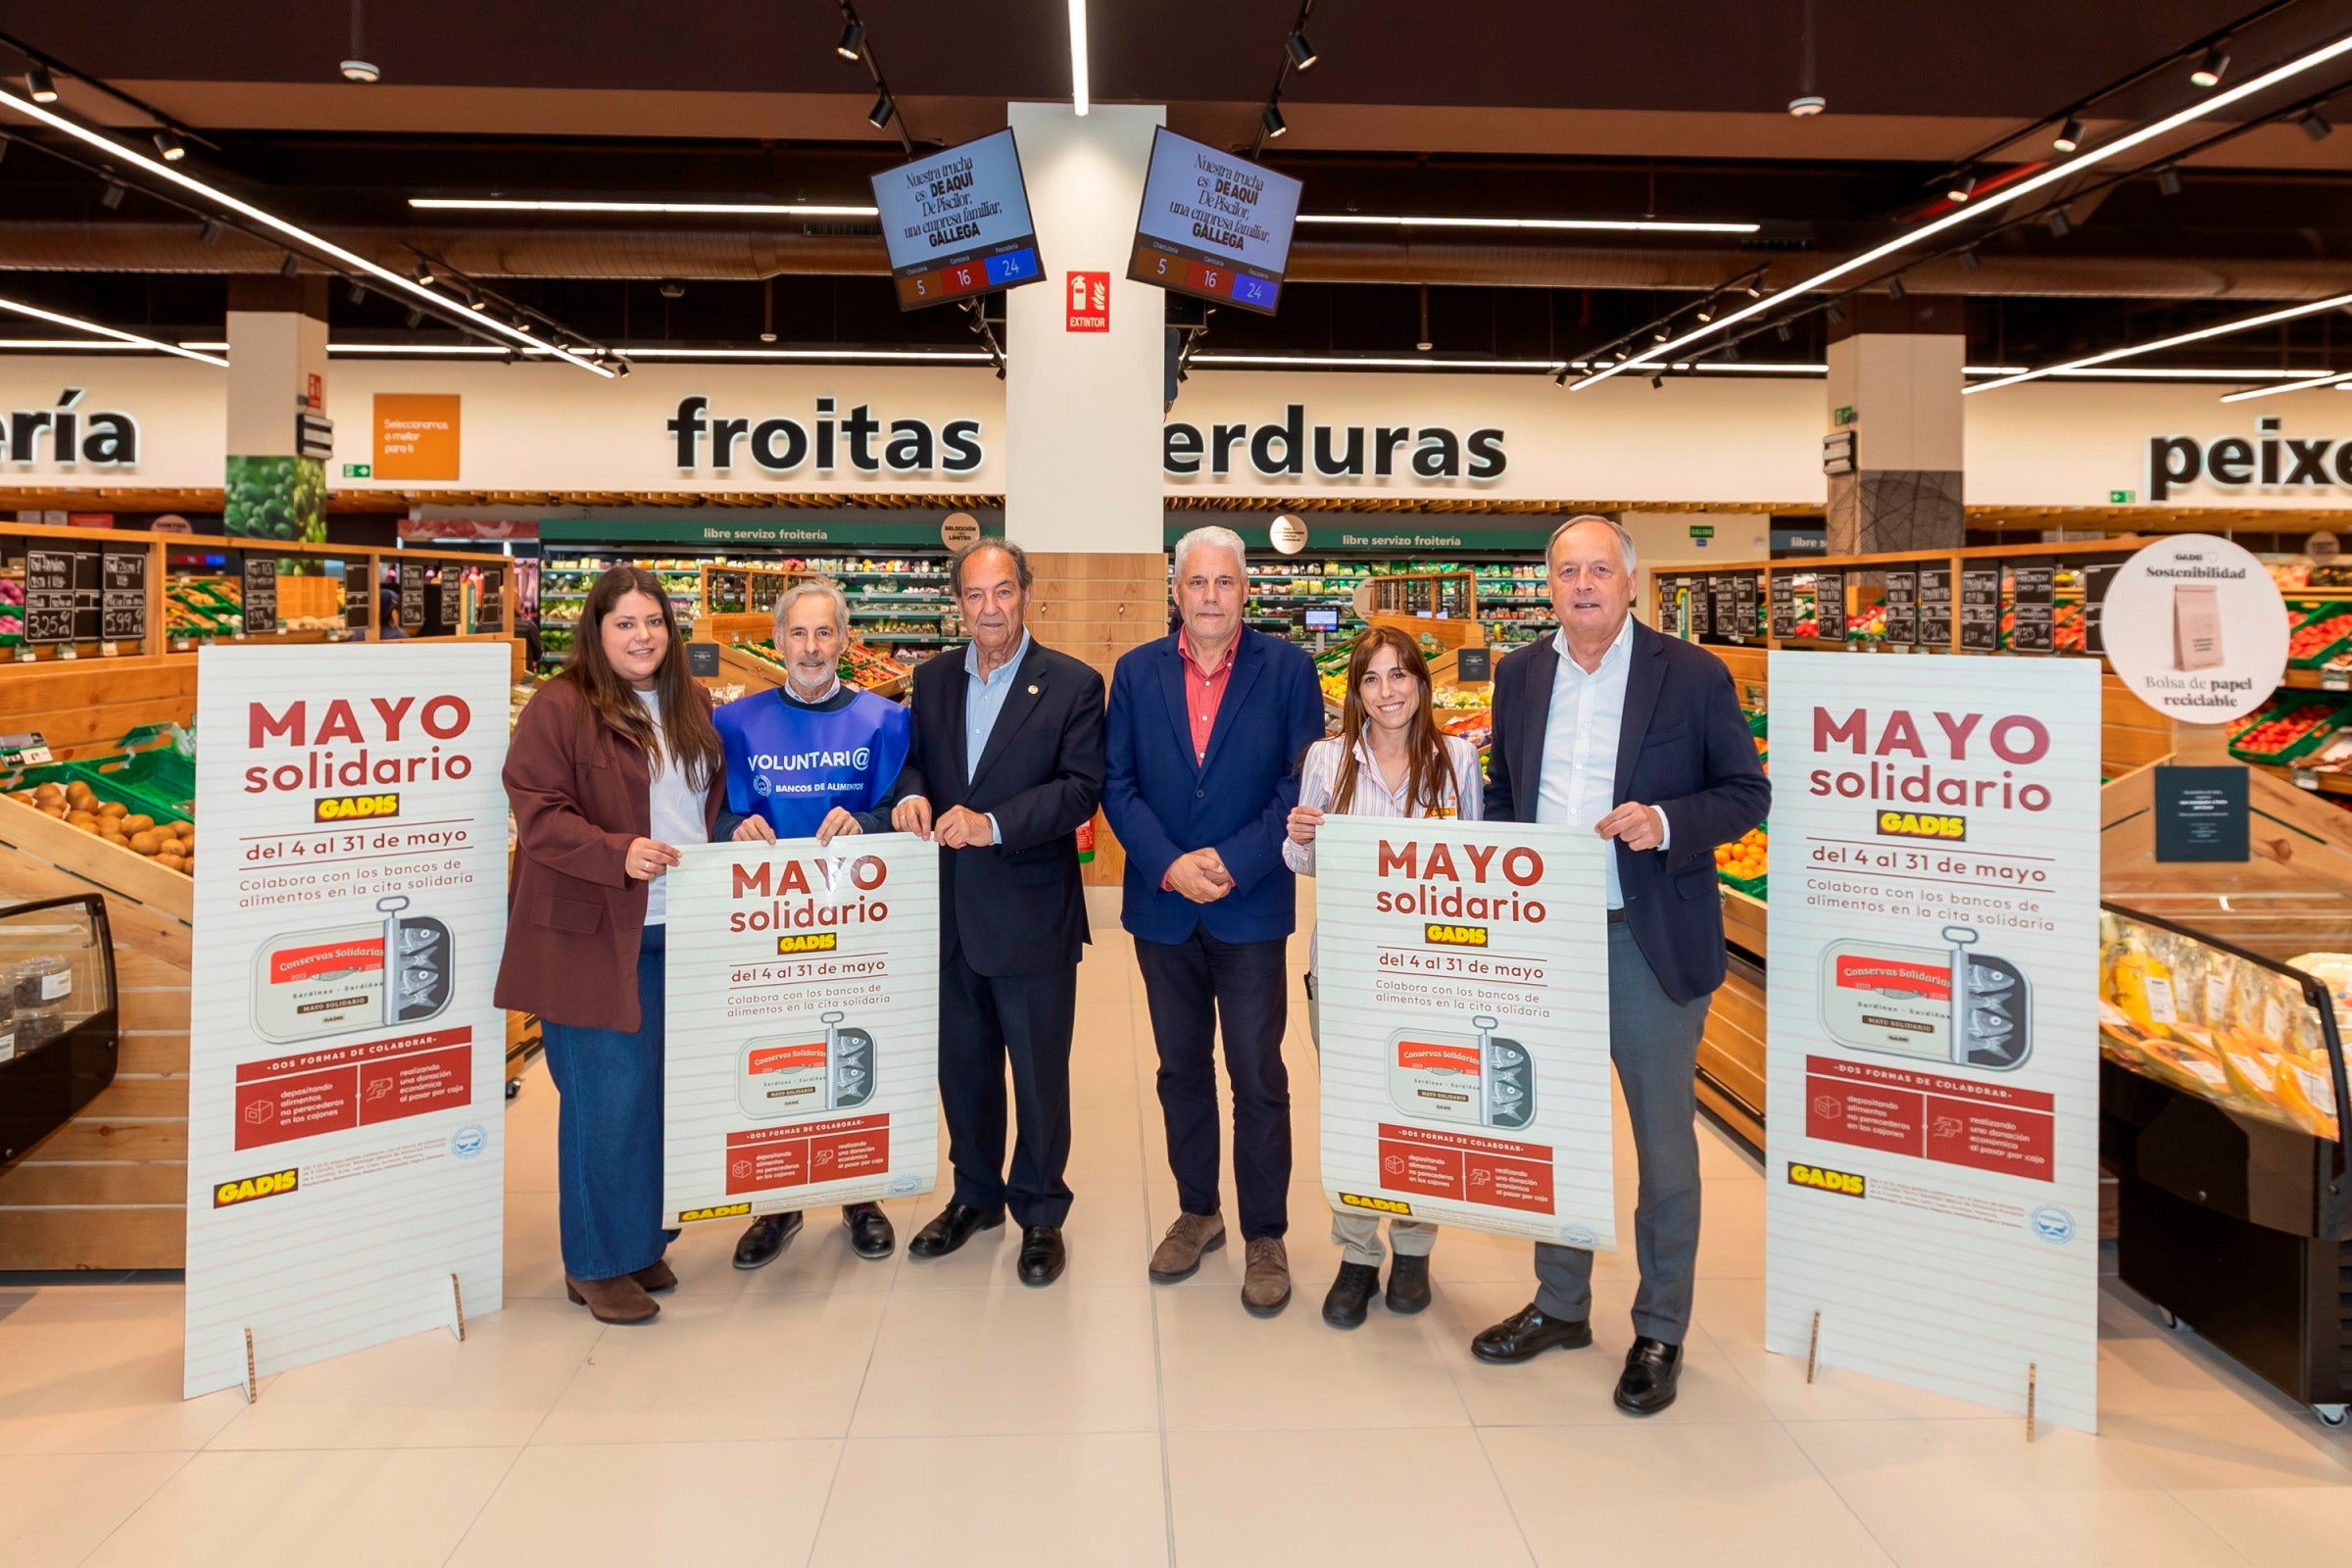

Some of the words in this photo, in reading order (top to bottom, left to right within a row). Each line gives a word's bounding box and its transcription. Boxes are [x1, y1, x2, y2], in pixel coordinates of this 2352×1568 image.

[907, 166, 941, 188] Nuestra
[942, 157, 973, 177] trucha
[1194, 154, 1232, 178] Nuestra
[1234, 170, 1264, 191] trucha
[915, 190, 924, 202] es
[931, 180, 945, 197] DE
[1198, 176, 1208, 187] es
[1215, 179, 1231, 195] DE
[923, 203, 935, 217] De
[1198, 190, 1214, 208] De
[905, 224, 921, 238] una
[923, 211, 961, 234] empresa
[963, 200, 1002, 222] familiar,
[1170, 201, 1189, 216] una
[1191, 206, 1232, 230] empresa
[1235, 219, 1270, 243] familiar,
[929, 222, 980, 247] GALLEGA
[1192, 222, 1244, 250] GALLEGA
[957, 269, 971, 285] 16
[1003, 258, 1019, 276] 24
[1157, 258, 1167, 274] 5
[917, 280, 925, 294] 5
[1205, 270, 1217, 288] 16
[1247, 283, 1262, 299] 24
[1070, 317, 1105, 327] EXTINTOR
[0, 388, 136, 463] ría
[667, 396, 982, 471] froitas
[385, 444, 406, 454] para
[704, 528, 731, 538] libre
[735, 529, 775, 539] servizo
[1343, 535, 1368, 545] libre
[1372, 536, 1411, 545] servizo
[1791, 537, 1817, 547] libre
[2147, 567, 2246, 578] Sostenibilidad
[2146, 676, 2185, 689] Bolsa
[2190, 677, 2207, 689] de
[2210, 678, 2252, 692] papel
[2164, 693, 2237, 707] reciclable
[249, 695, 471, 749] MAYO
[1813, 706, 2051, 765] MAYO
[244, 746, 471, 793] solidario
[748, 747, 870, 772] VOLUNTARI@
[827, 782, 864, 791] ALIMENTOS
[1809, 761, 2052, 812] solidario
[318, 794, 397, 819] GADIS
[1881, 813, 1964, 838] GADIS
[246, 842, 282, 860] del
[291, 841, 305, 856] 4
[314, 838, 333, 854] al
[343, 835, 364, 851] 31
[373, 833, 399, 849] de
[407, 830, 467, 847] mayo
[1378, 839, 1544, 887] MAYO
[1813, 846, 1846, 863] del
[1855, 849, 1868, 865] 4
[1876, 852, 1896, 868] al
[1906, 854, 1928, 871] 31
[1938, 857, 1966, 874] de
[1976, 864, 2046, 883] mayo
[239, 875, 315, 892] Colabora
[323, 872, 350, 883] con
[357, 868, 378, 879] los
[385, 863, 438, 876] bancos
[444, 859, 461, 871] de
[732, 855, 887, 899] MAYO
[239, 889, 321, 907] alimentos
[328, 887, 346, 897] en
[353, 884, 366, 895] la
[373, 880, 402, 893] cita
[408, 874, 473, 890] solidaria
[1807, 879, 1879, 896] Colabora
[1886, 887, 1914, 899] con
[1921, 889, 1943, 902] los
[1950, 892, 2011, 910] bancos
[2019, 900, 2039, 912] de
[730, 895, 888, 932] solidario
[1376, 884, 1546, 923] solidario
[1807, 895, 1885, 912] alimentos
[1891, 904, 1910, 916] en
[1917, 905, 1931, 918] la
[1938, 909, 1970, 922] cita
[1977, 913, 2055, 931] solidaria
[780, 934, 836, 952] GADIS
[1427, 925, 1487, 945] GADIS
[279, 952, 333, 972] Conservas
[732, 969, 756, 982] del
[762, 968, 771, 979] 4
[777, 967, 791, 978] al
[797, 964, 812, 976] 31
[818, 963, 837, 975] de
[842, 961, 885, 974] mayo
[1379, 953, 1403, 966] del
[1410, 955, 1419, 968] 4
[1426, 957, 1440, 970] al
[1446, 958, 1462, 971] 31
[1468, 960, 1489, 973] de
[1495, 965, 1543, 980] mayo
[1845, 968, 1897, 977] Conservas
[728, 993, 779, 1005] Colabora
[783, 991, 802, 1000] con
[807, 989, 822, 998] los
[826, 986, 864, 996] bancos
[869, 984, 881, 992] de
[1376, 980, 1427, 993] Colabora
[1432, 986, 1452, 995] con
[1457, 987, 1473, 997] los
[1478, 989, 1520, 1001] bancos
[1525, 993, 1539, 1003] de
[728, 1005, 783, 1017] alimentos
[787, 1003, 800, 1012] en
[804, 1002, 814, 1011] la
[818, 999, 838, 1009] cita
[843, 994, 890, 1007] solidaria
[1376, 993, 1431, 1006] alimentos
[1436, 999, 1450, 1007] en
[1455, 1000, 1464, 1009] la
[1470, 1002, 1491, 1012] cita
[1497, 1005, 1550, 1017] solidaria
[300, 1052, 346, 1065] FORMAS
[351, 1049, 364, 1057] DE
[217, 1170, 296, 1204] GADIS
[1791, 1164, 1864, 1195] GADIS
[681, 1204, 750, 1221] GADIS
[1343, 1194, 1410, 1215] GADIS
